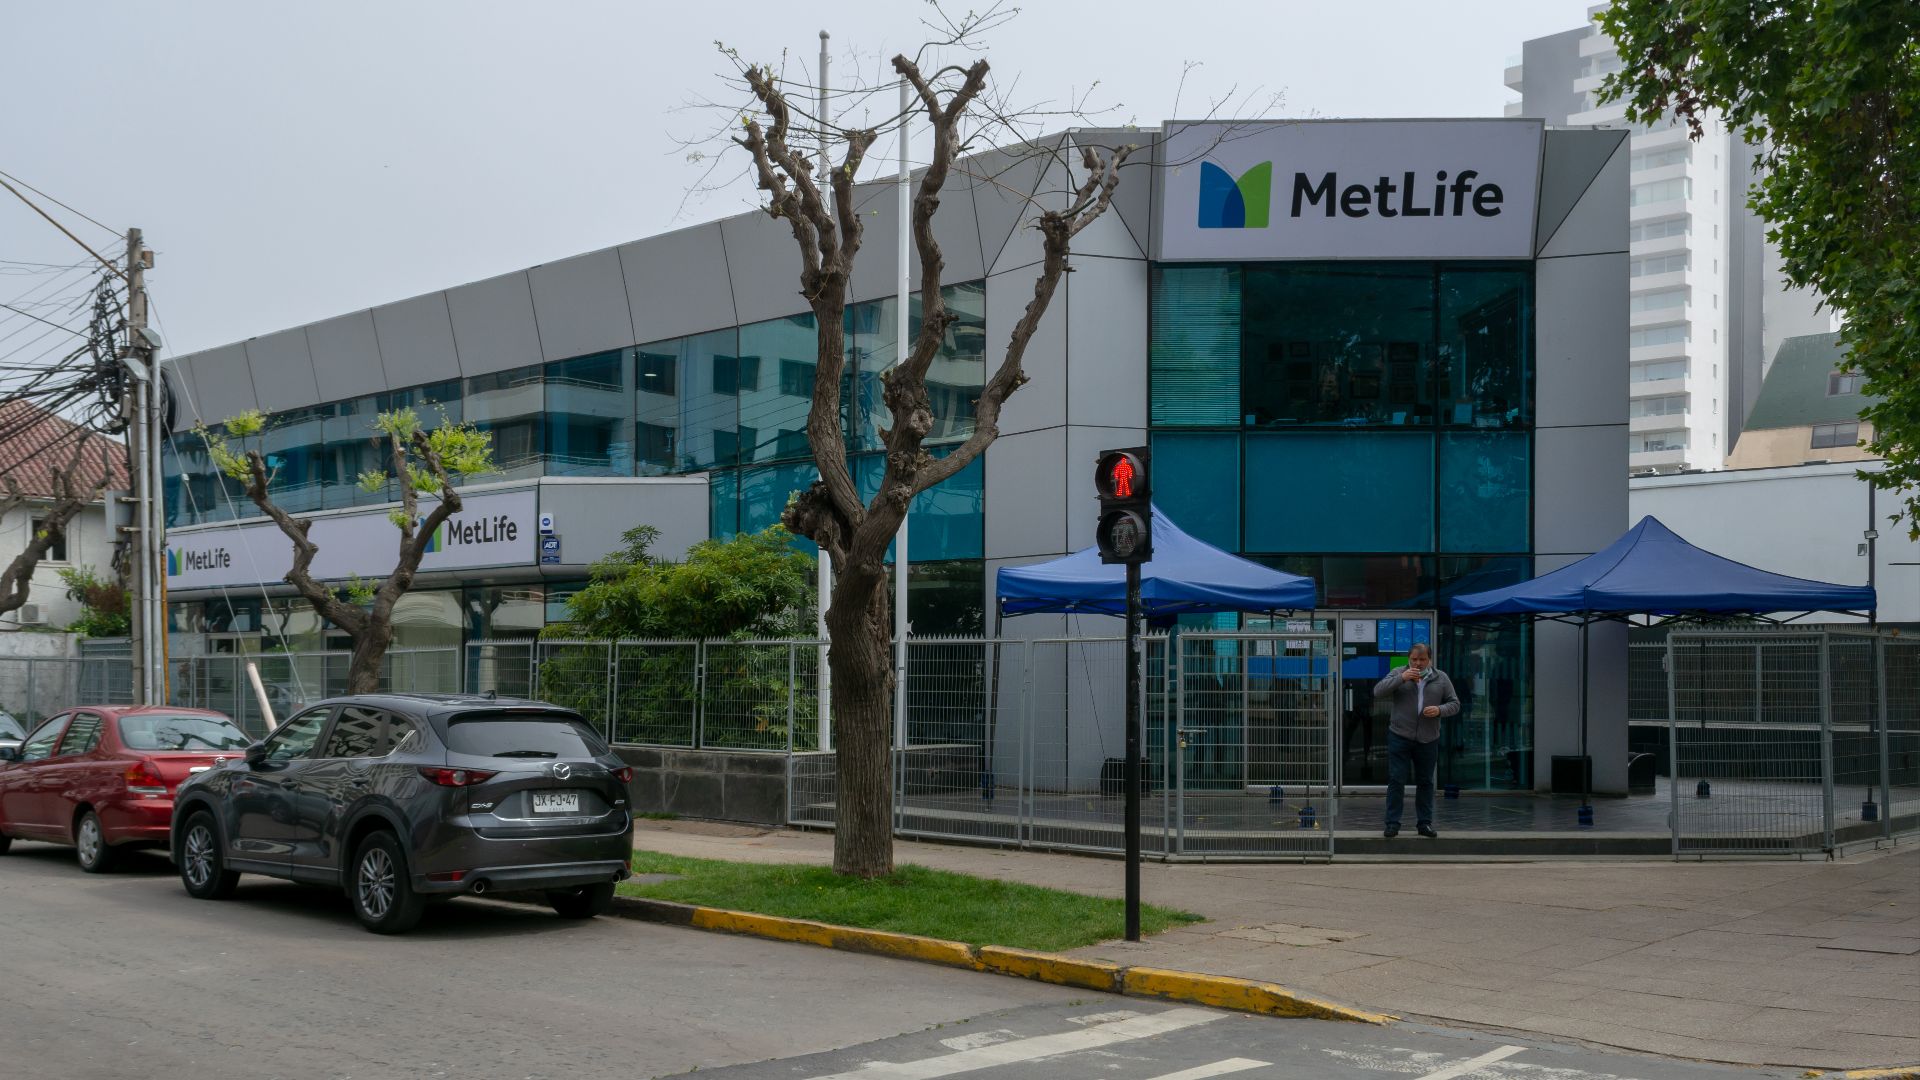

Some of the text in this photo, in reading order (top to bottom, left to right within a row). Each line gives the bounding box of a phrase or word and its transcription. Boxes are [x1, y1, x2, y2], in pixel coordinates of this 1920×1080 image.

[1291, 169, 1504, 218] MetLife
[447, 515, 518, 546] MetLife
[186, 547, 231, 571] MetLife
